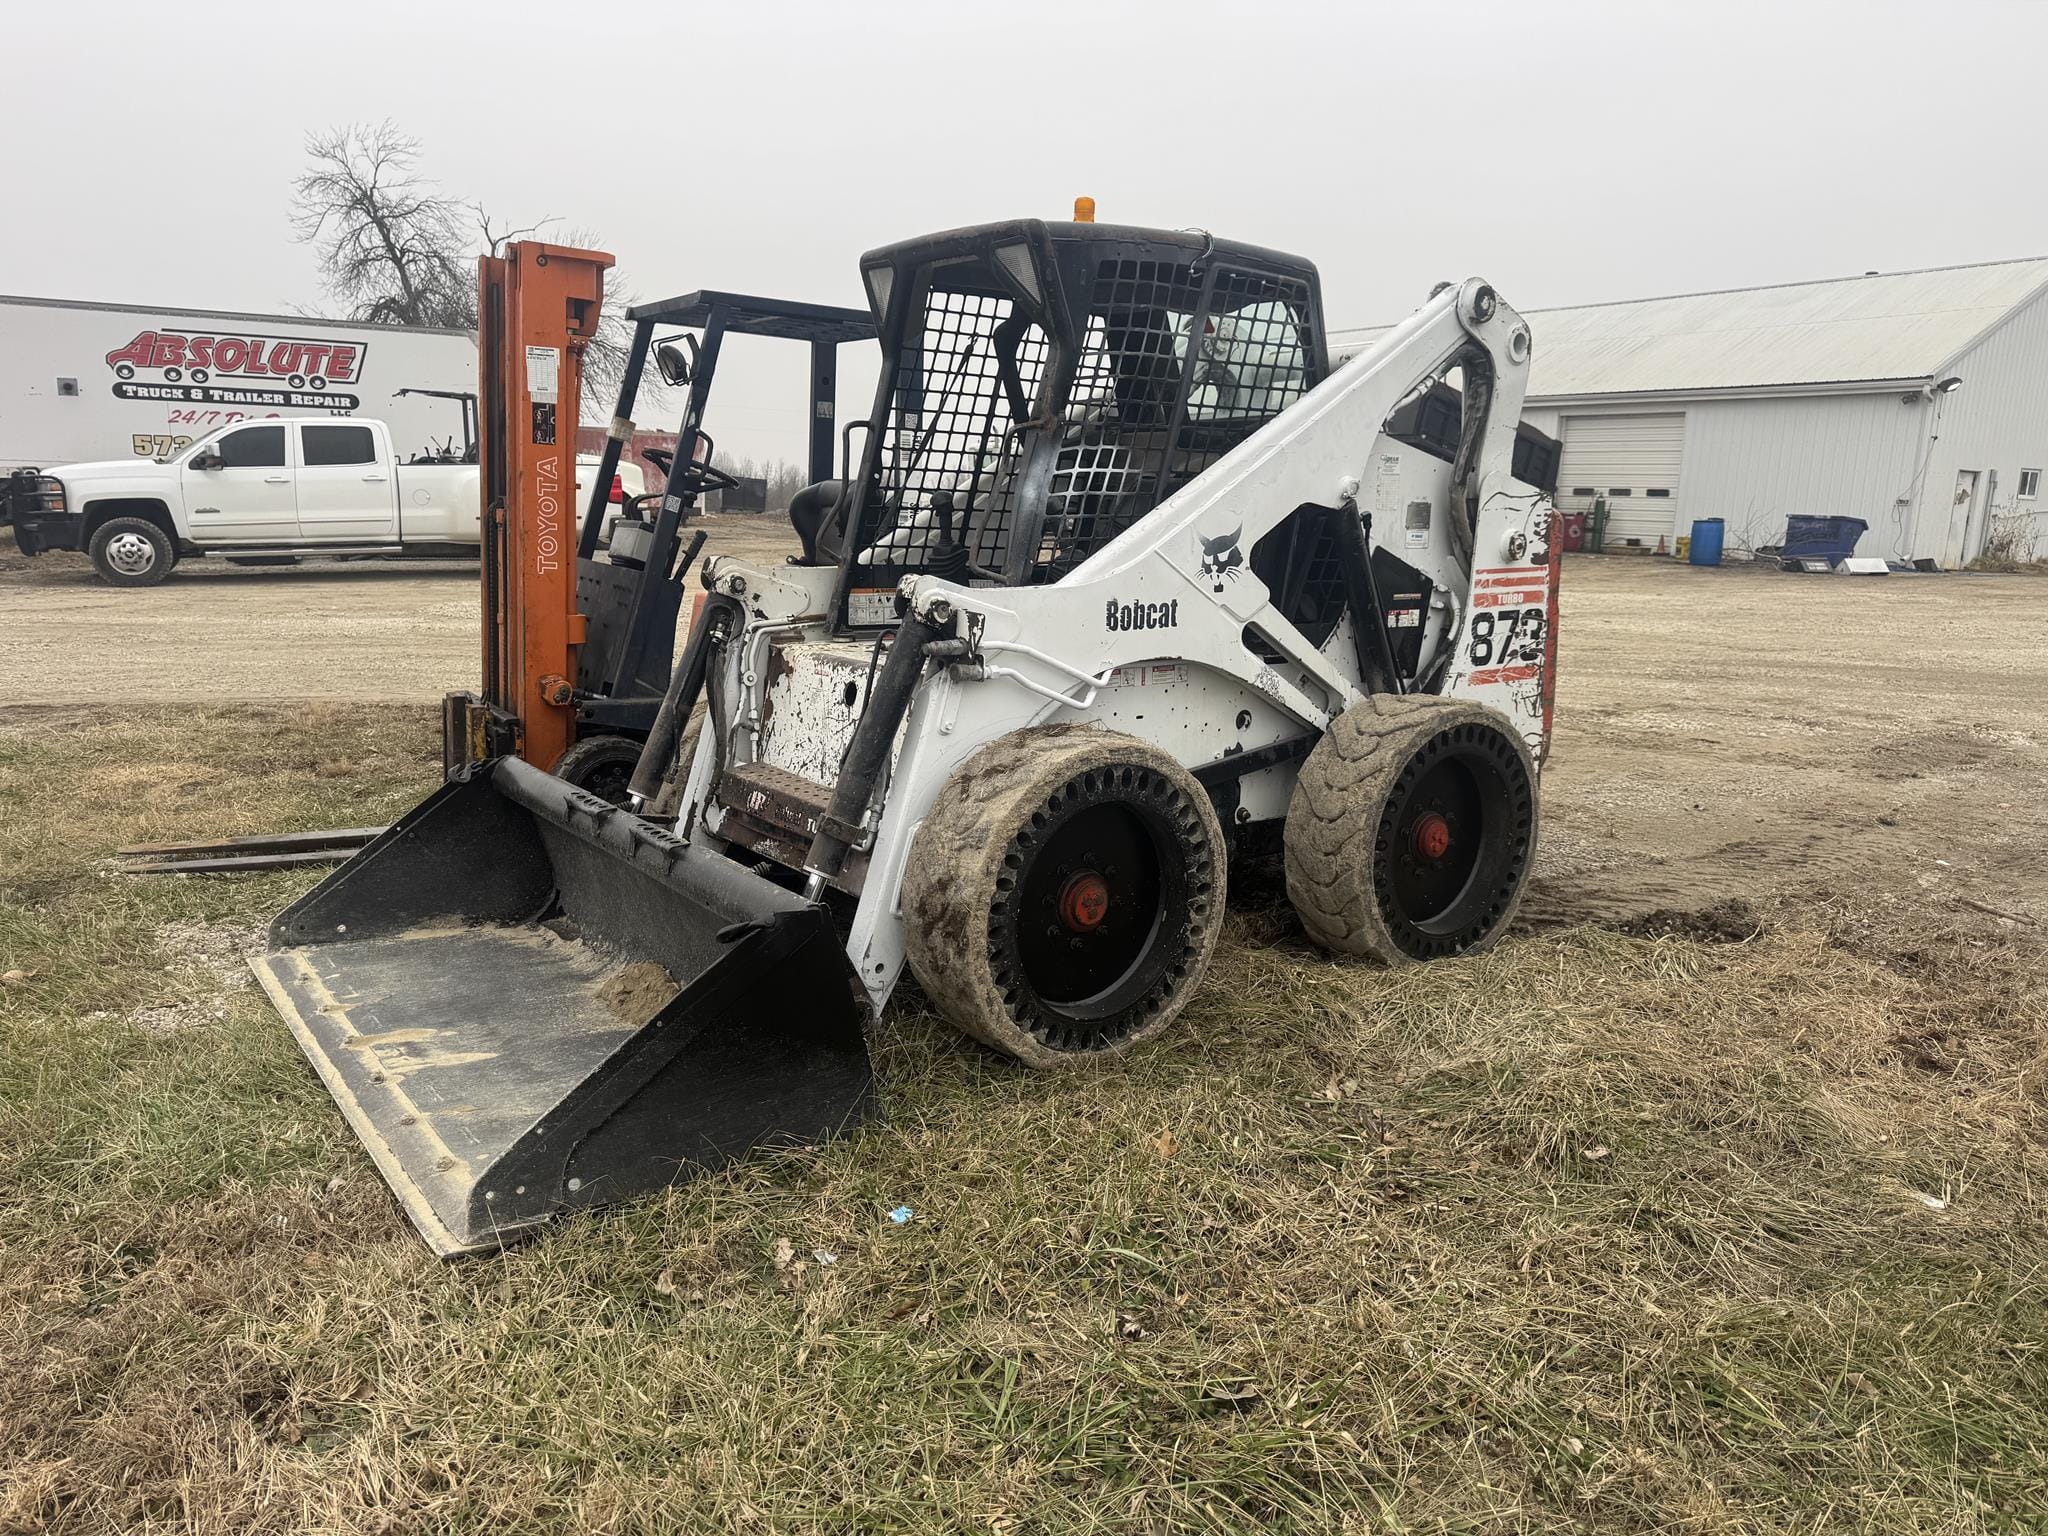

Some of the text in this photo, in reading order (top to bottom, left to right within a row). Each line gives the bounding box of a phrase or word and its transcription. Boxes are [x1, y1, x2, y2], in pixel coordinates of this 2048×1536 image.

[105, 331, 357, 380] ABSOLUTE
[122, 385, 352, 408] TRUCK & TRAILER REPAIR
[167, 409, 221, 425] 24/7
[330, 409, 352, 417] LLC
[536, 456, 559, 575] TOYOTA
[1497, 593, 1525, 605] TURBO
[1105, 598, 1179, 633] Bobcat
[1469, 608, 1545, 667] 873
